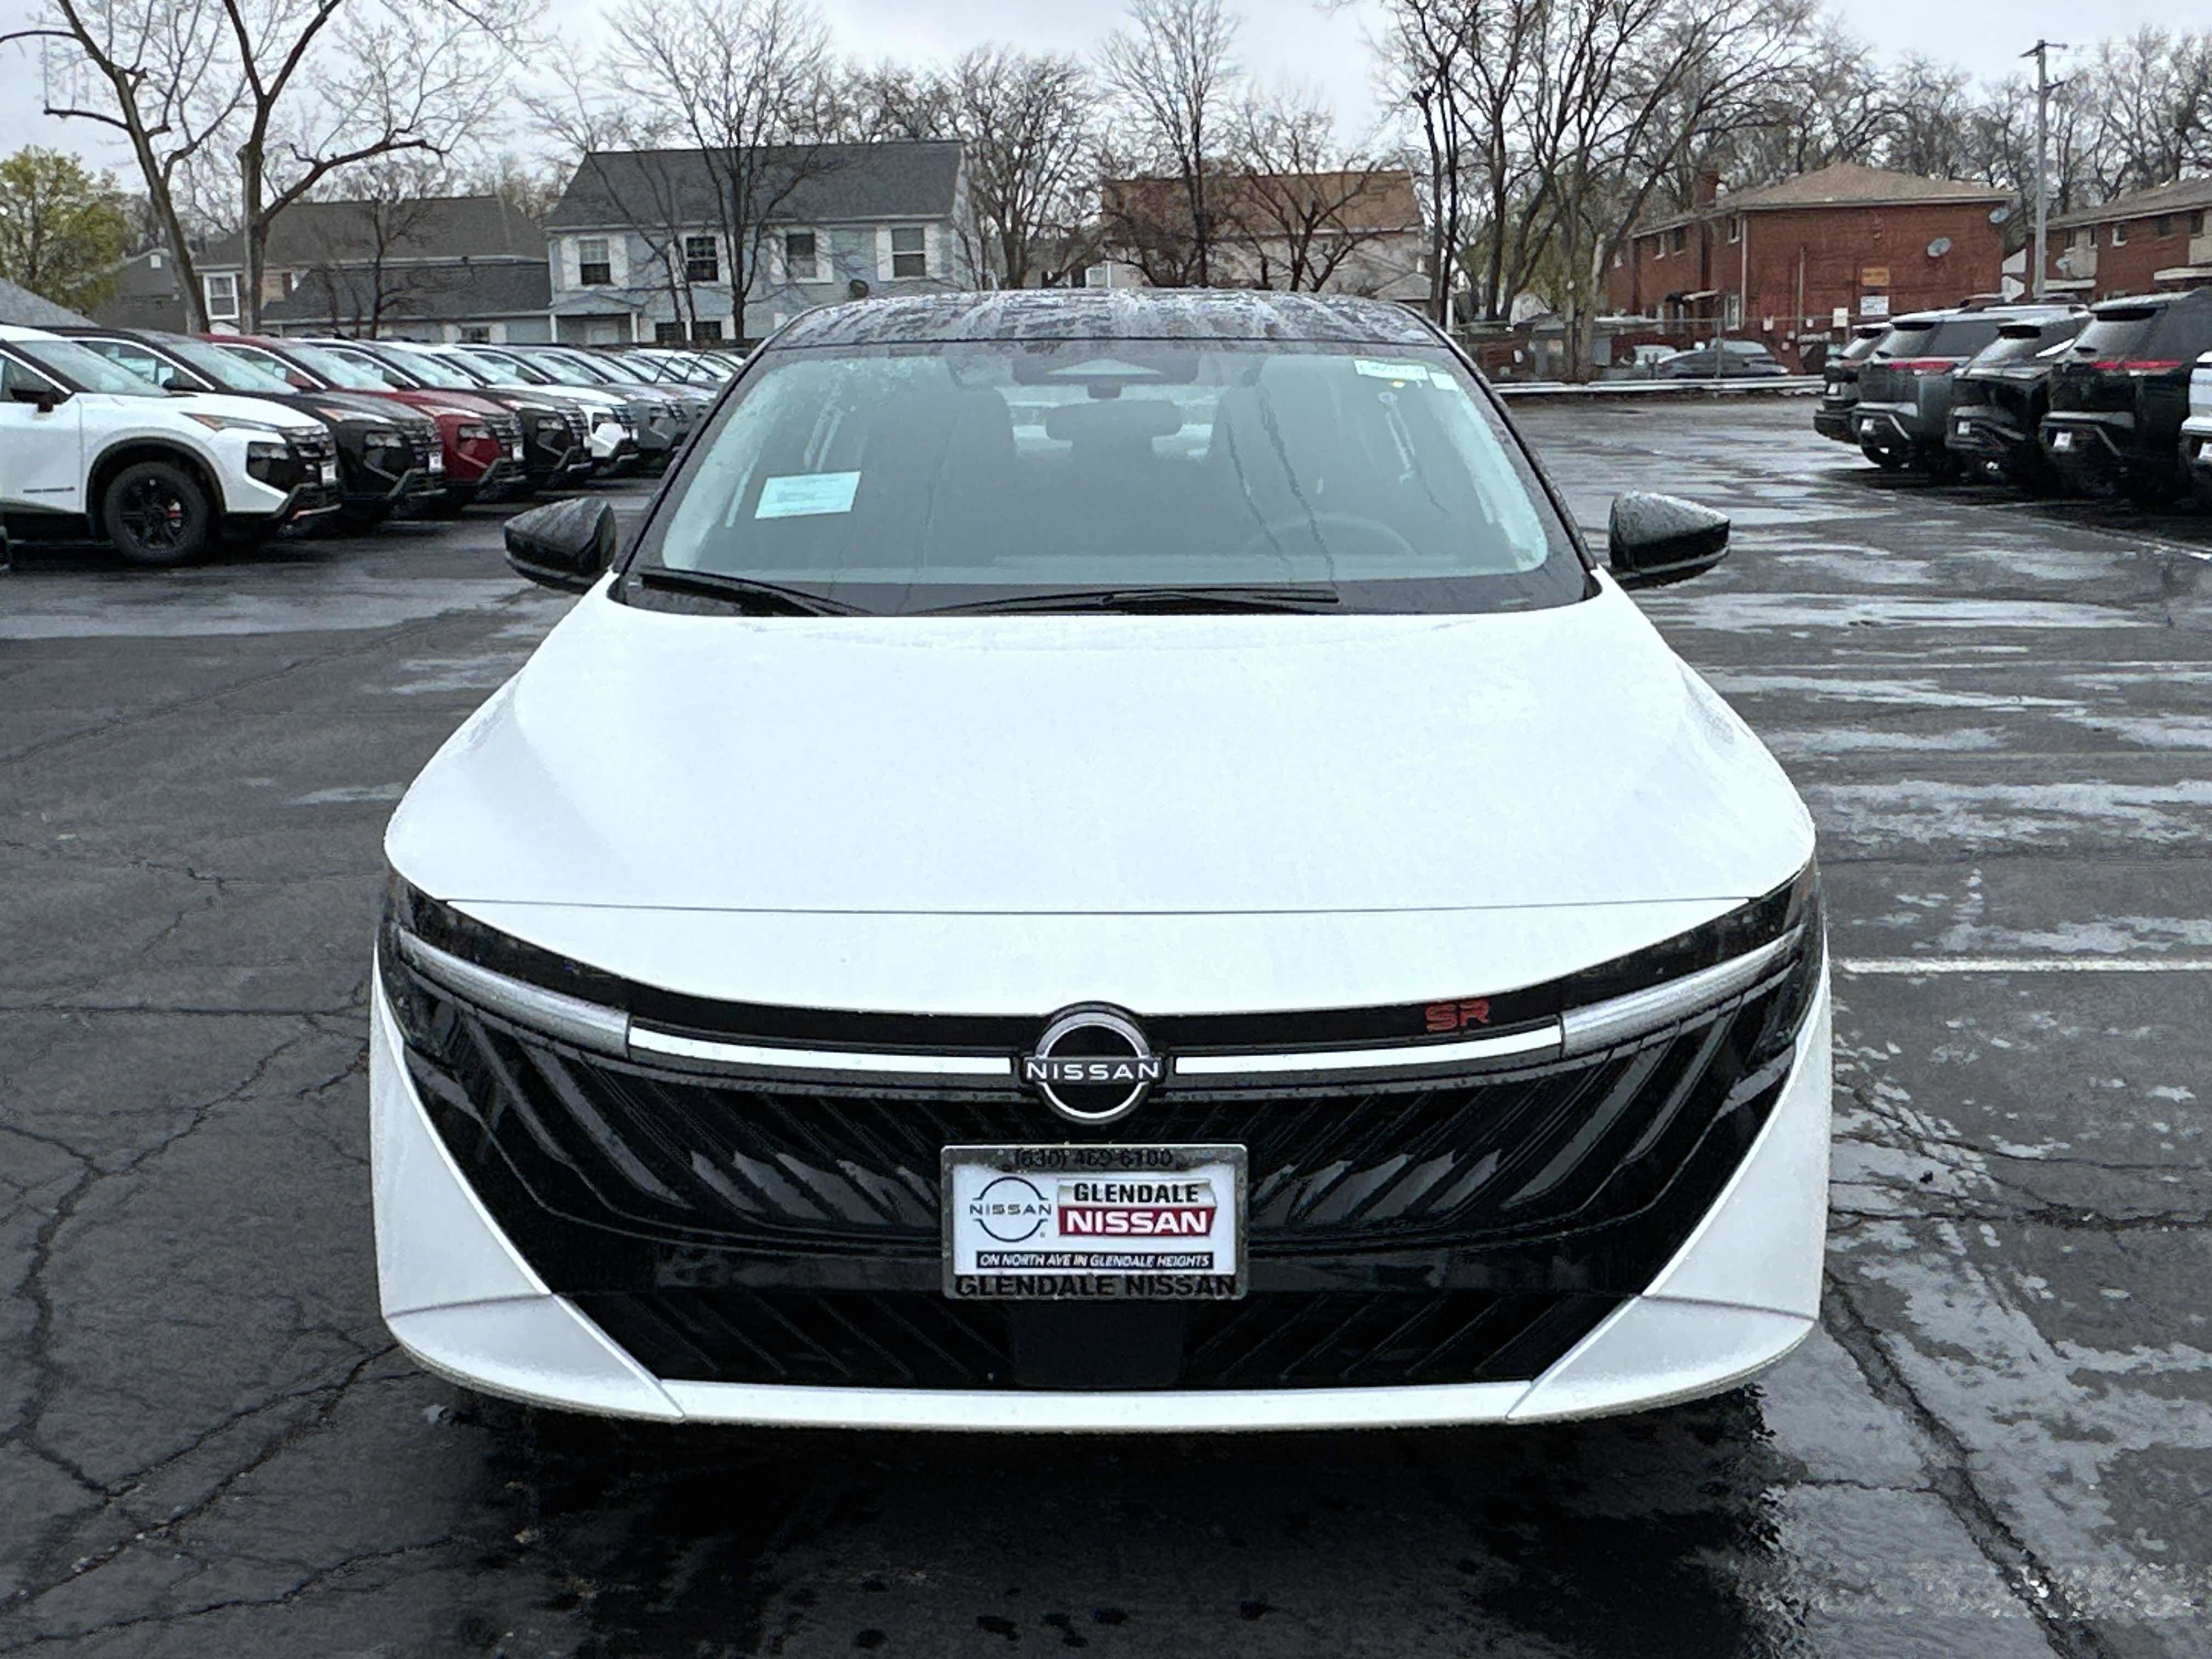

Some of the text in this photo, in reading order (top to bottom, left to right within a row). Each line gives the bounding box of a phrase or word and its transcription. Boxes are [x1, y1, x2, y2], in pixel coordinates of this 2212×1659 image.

[1425, 998, 1489, 1031] SR
[1026, 1062, 1159, 1080] NISSAN
[1074, 1183, 1198, 1203] GLENDALE
[969, 1204, 1052, 1215] NISSAN
[1067, 1211, 1207, 1233] NISSAN
[980, 1254, 1210, 1267] ON NORTH AVE IN GLENDALE HEIGHTS
[956, 1275, 1238, 1296] GLENDALE NISSAN
